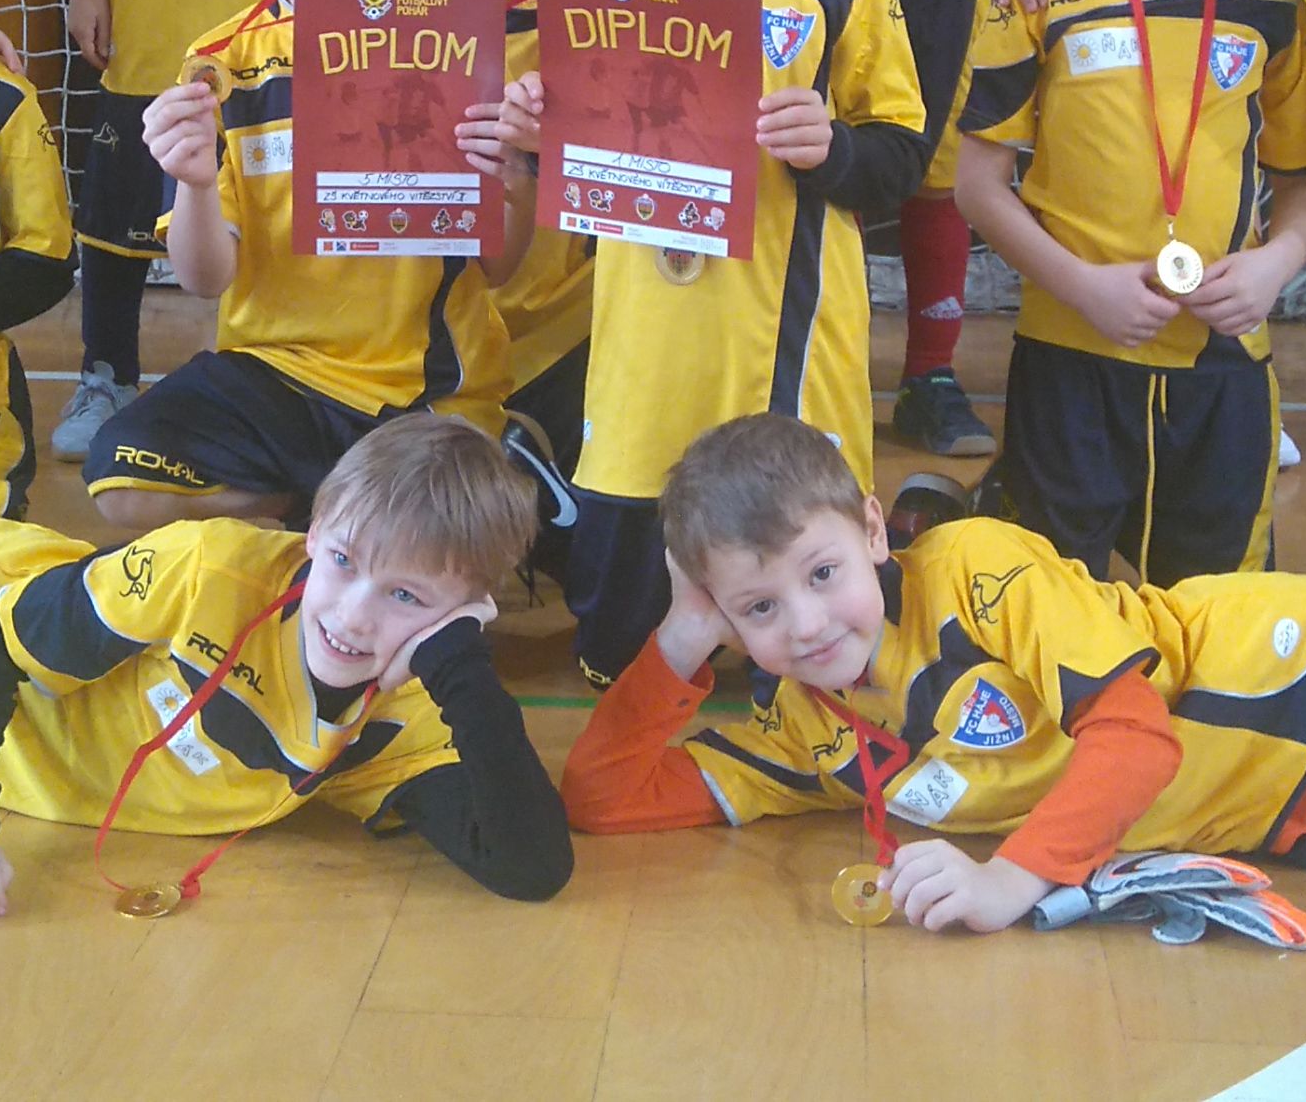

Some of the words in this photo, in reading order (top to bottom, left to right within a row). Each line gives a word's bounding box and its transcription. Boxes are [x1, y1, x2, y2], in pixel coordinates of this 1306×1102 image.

[564, 8, 733, 69] DIPLOM
[766, 17, 780, 26] FC
[318, 28, 478, 77] DIPLOM
[115, 445, 205, 486] ROYAL
[965, 719, 978, 736] FC
